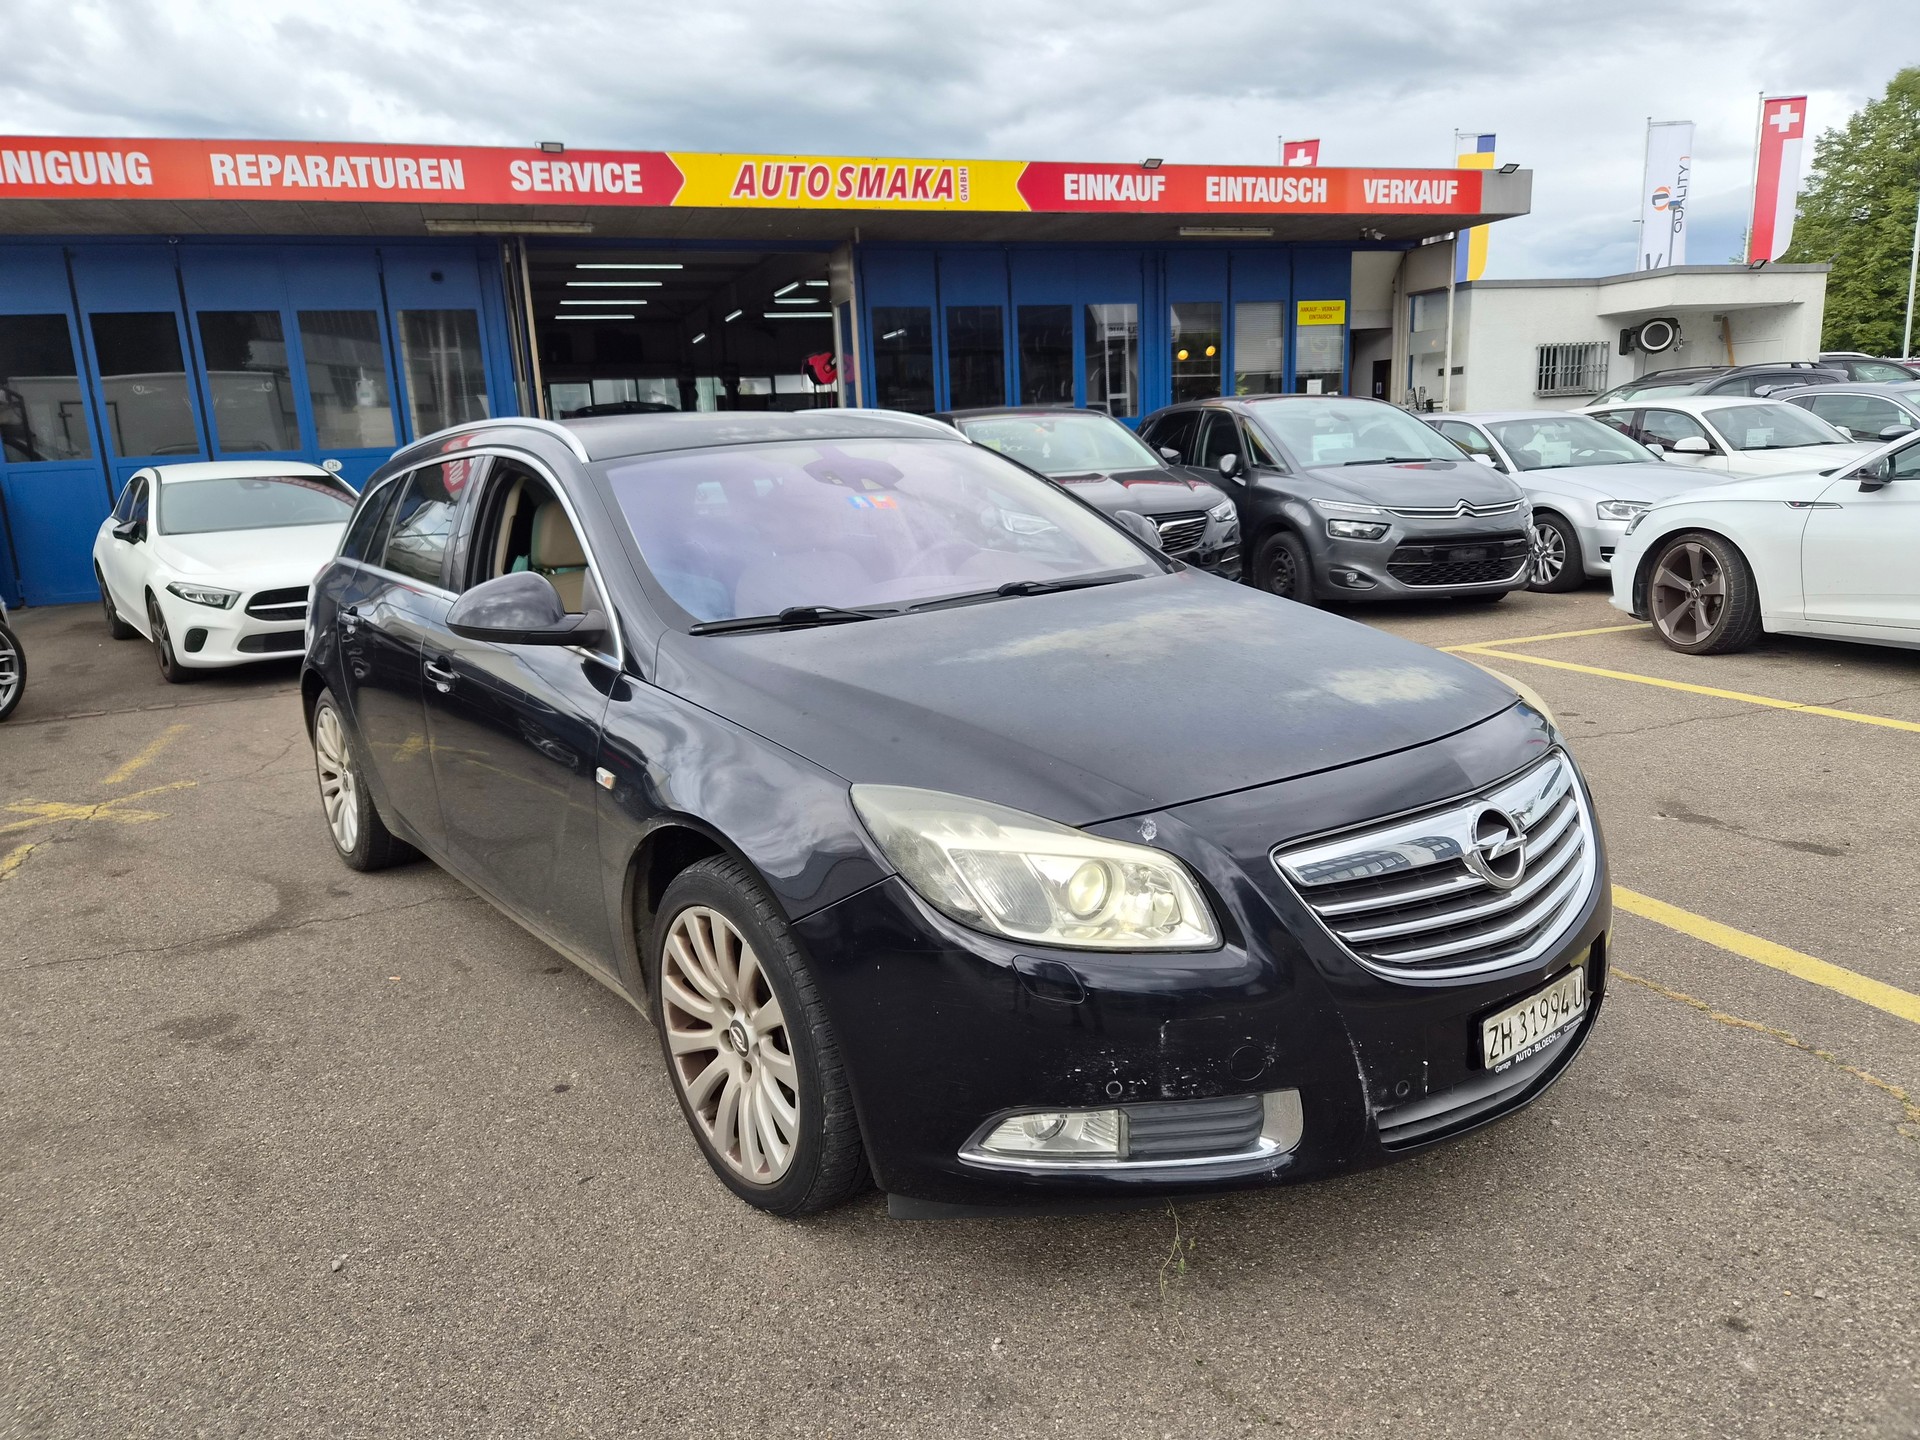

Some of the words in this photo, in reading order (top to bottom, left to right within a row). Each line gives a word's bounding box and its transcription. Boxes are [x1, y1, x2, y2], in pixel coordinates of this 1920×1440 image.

[0, 150, 154, 185] NIGUNG
[210, 153, 466, 191] REPARATUREN
[509, 160, 643, 194] SERVICE
[732, 163, 831, 199] AUTO
[836, 165, 955, 200] SMAKA
[959, 167, 969, 201] GMBH
[1063, 173, 1166, 202] EINKAUF
[1206, 176, 1328, 204] EINTAUSCH
[1363, 178, 1459, 205] VERKAUF
[327, 461, 338, 470] CH
[1487, 1018, 1513, 1063] ZH
[1495, 1060, 1512, 1074] Garage
